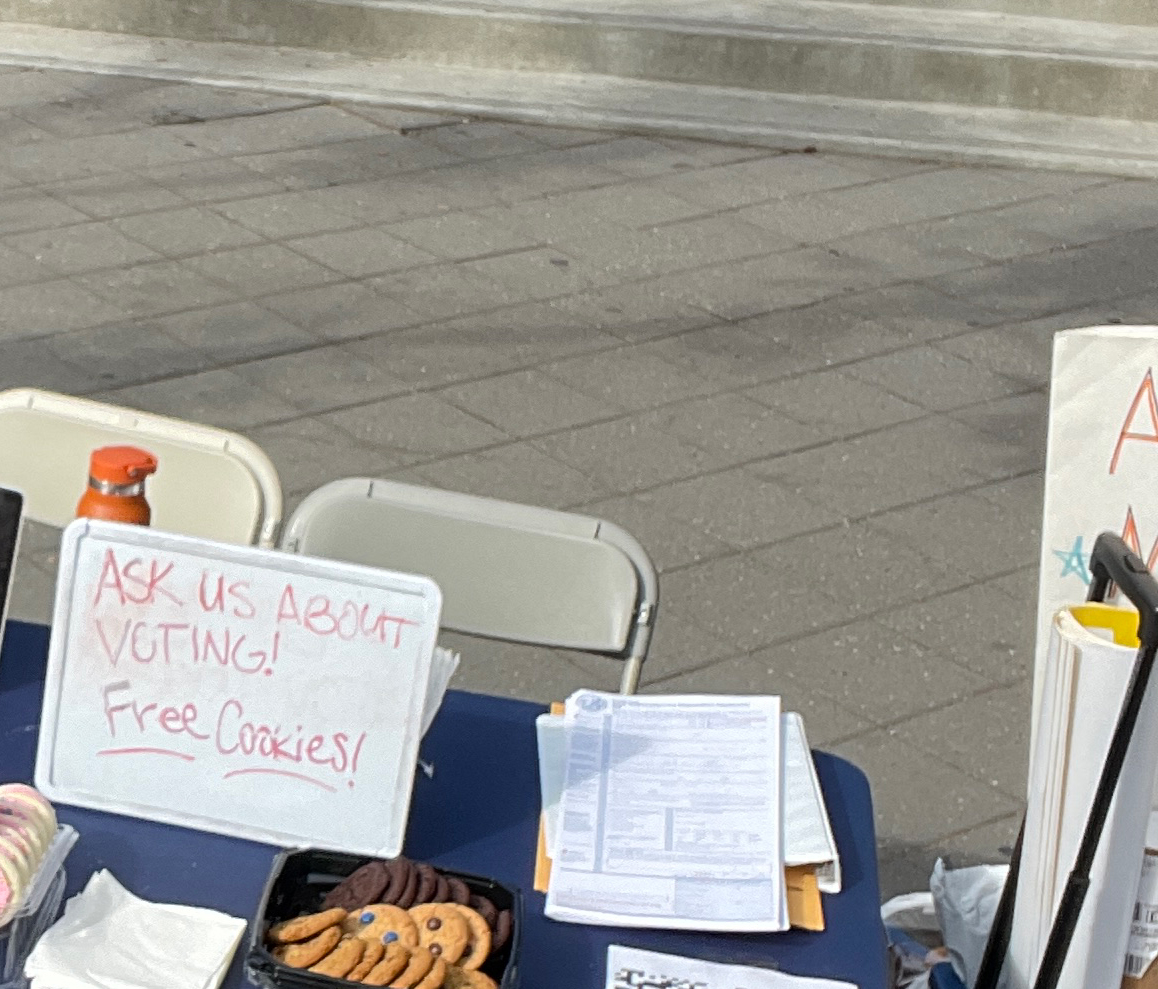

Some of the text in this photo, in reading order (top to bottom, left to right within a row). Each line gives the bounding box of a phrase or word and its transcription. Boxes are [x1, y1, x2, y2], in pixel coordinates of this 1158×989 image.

[93, 548, 420, 648] ASK US ABOUT
[95, 618, 280, 676] VOTING!
[102, 679, 367, 788] Free Cookies!
